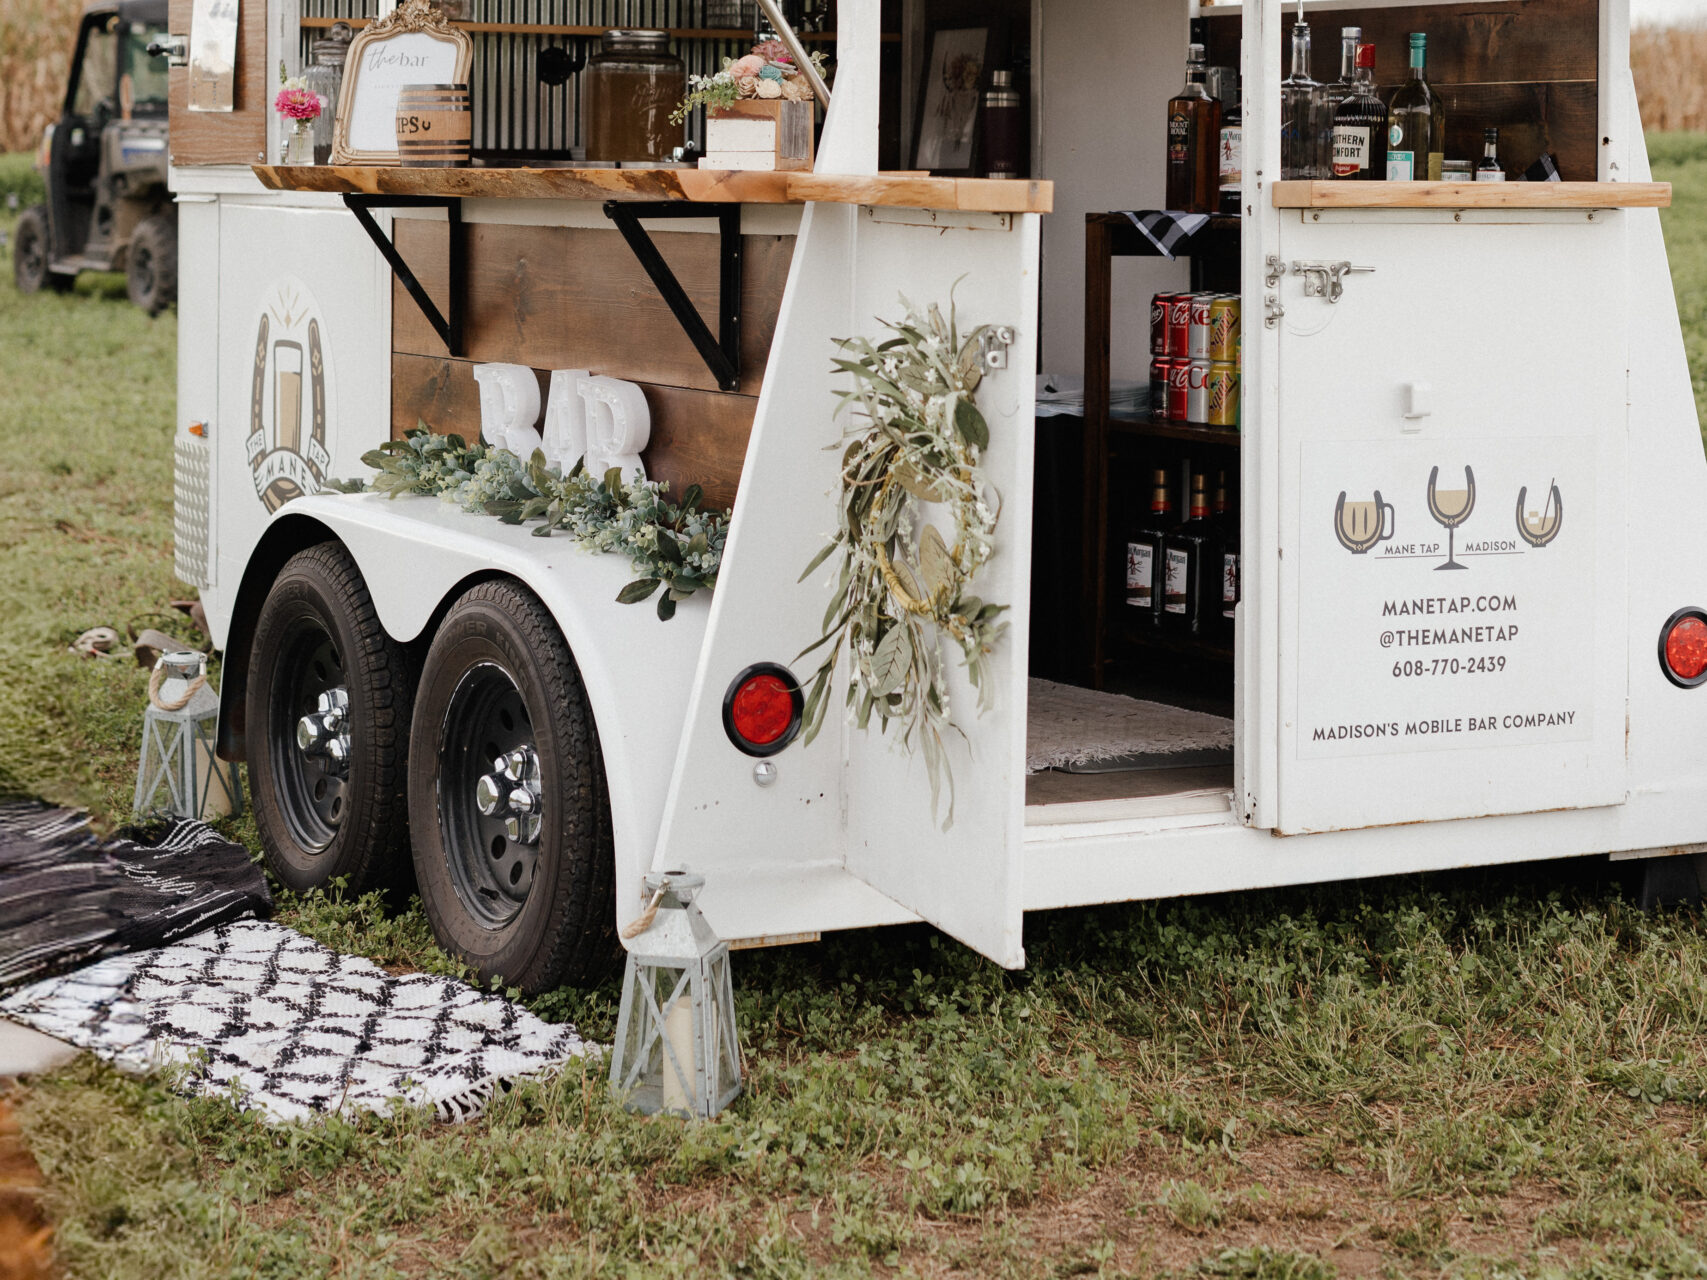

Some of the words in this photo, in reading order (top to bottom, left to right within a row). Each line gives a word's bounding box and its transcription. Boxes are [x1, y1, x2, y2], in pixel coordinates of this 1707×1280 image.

[399, 52, 429, 67] bar
[397, 116, 419, 134] IPS
[265, 455, 307, 490] MANE
[1384, 544, 1416, 556] MANE
[1420, 543, 1440, 555] TAP
[1465, 540, 1517, 553] MADISON
[1382, 595, 1518, 617] MANETAP.COM
[1379, 624, 1520, 649] @THEMANETAP
[1392, 655, 1507, 678] 608-770-2439
[1312, 722, 1400, 742] MADISON'S
[1404, 718, 1463, 736] MOBILE
[1468, 715, 1498, 732] BAR
[1502, 711, 1576, 729] COMPANY
